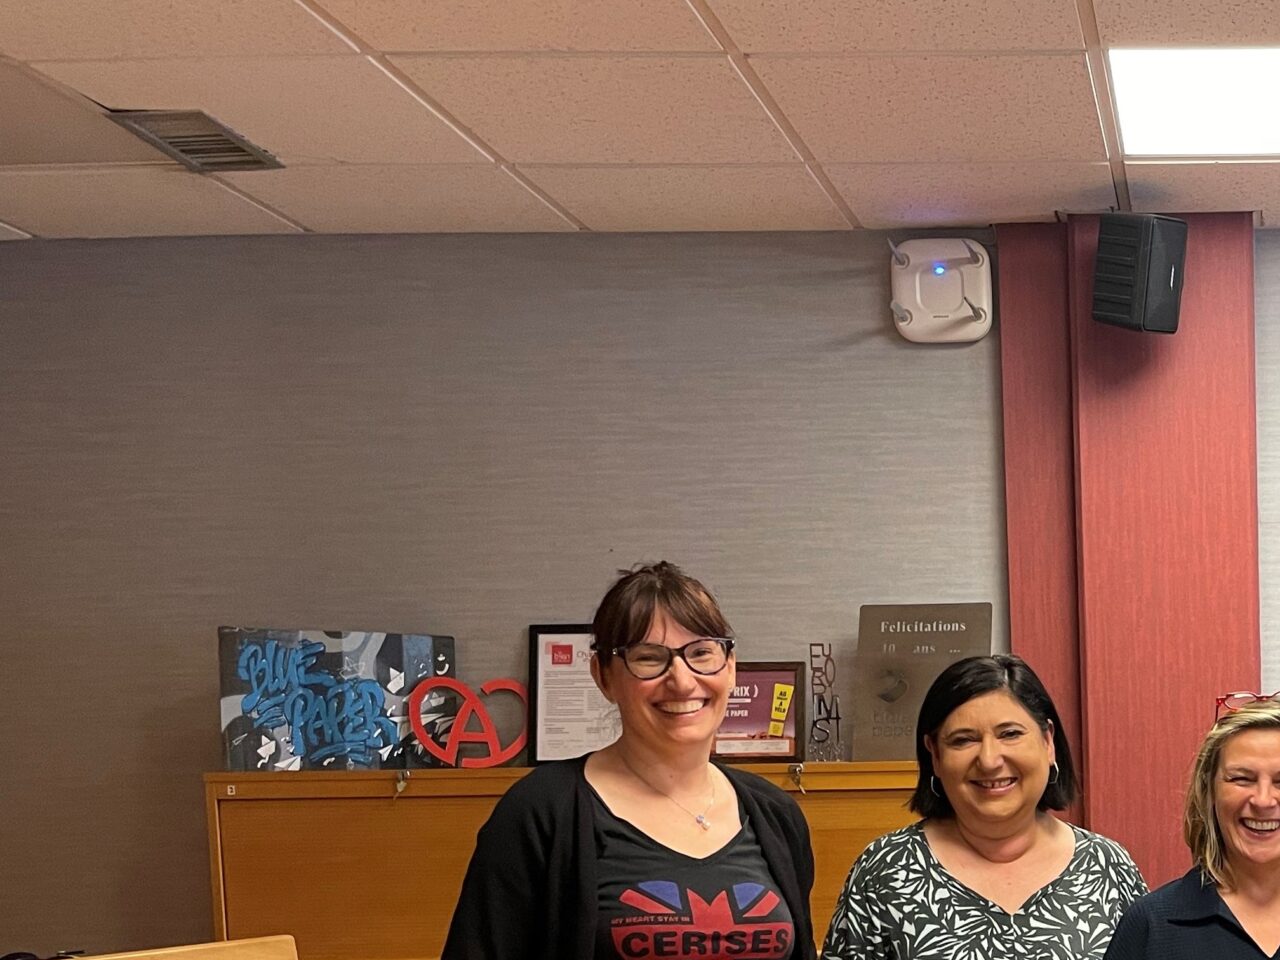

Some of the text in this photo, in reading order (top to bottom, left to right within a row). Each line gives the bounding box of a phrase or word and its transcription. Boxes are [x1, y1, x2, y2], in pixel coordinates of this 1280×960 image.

[880, 620, 967, 633] Felicitations
[912, 645, 936, 654] ans
[625, 915, 655, 923] HEART
[621, 928, 790, 958] CERISES
